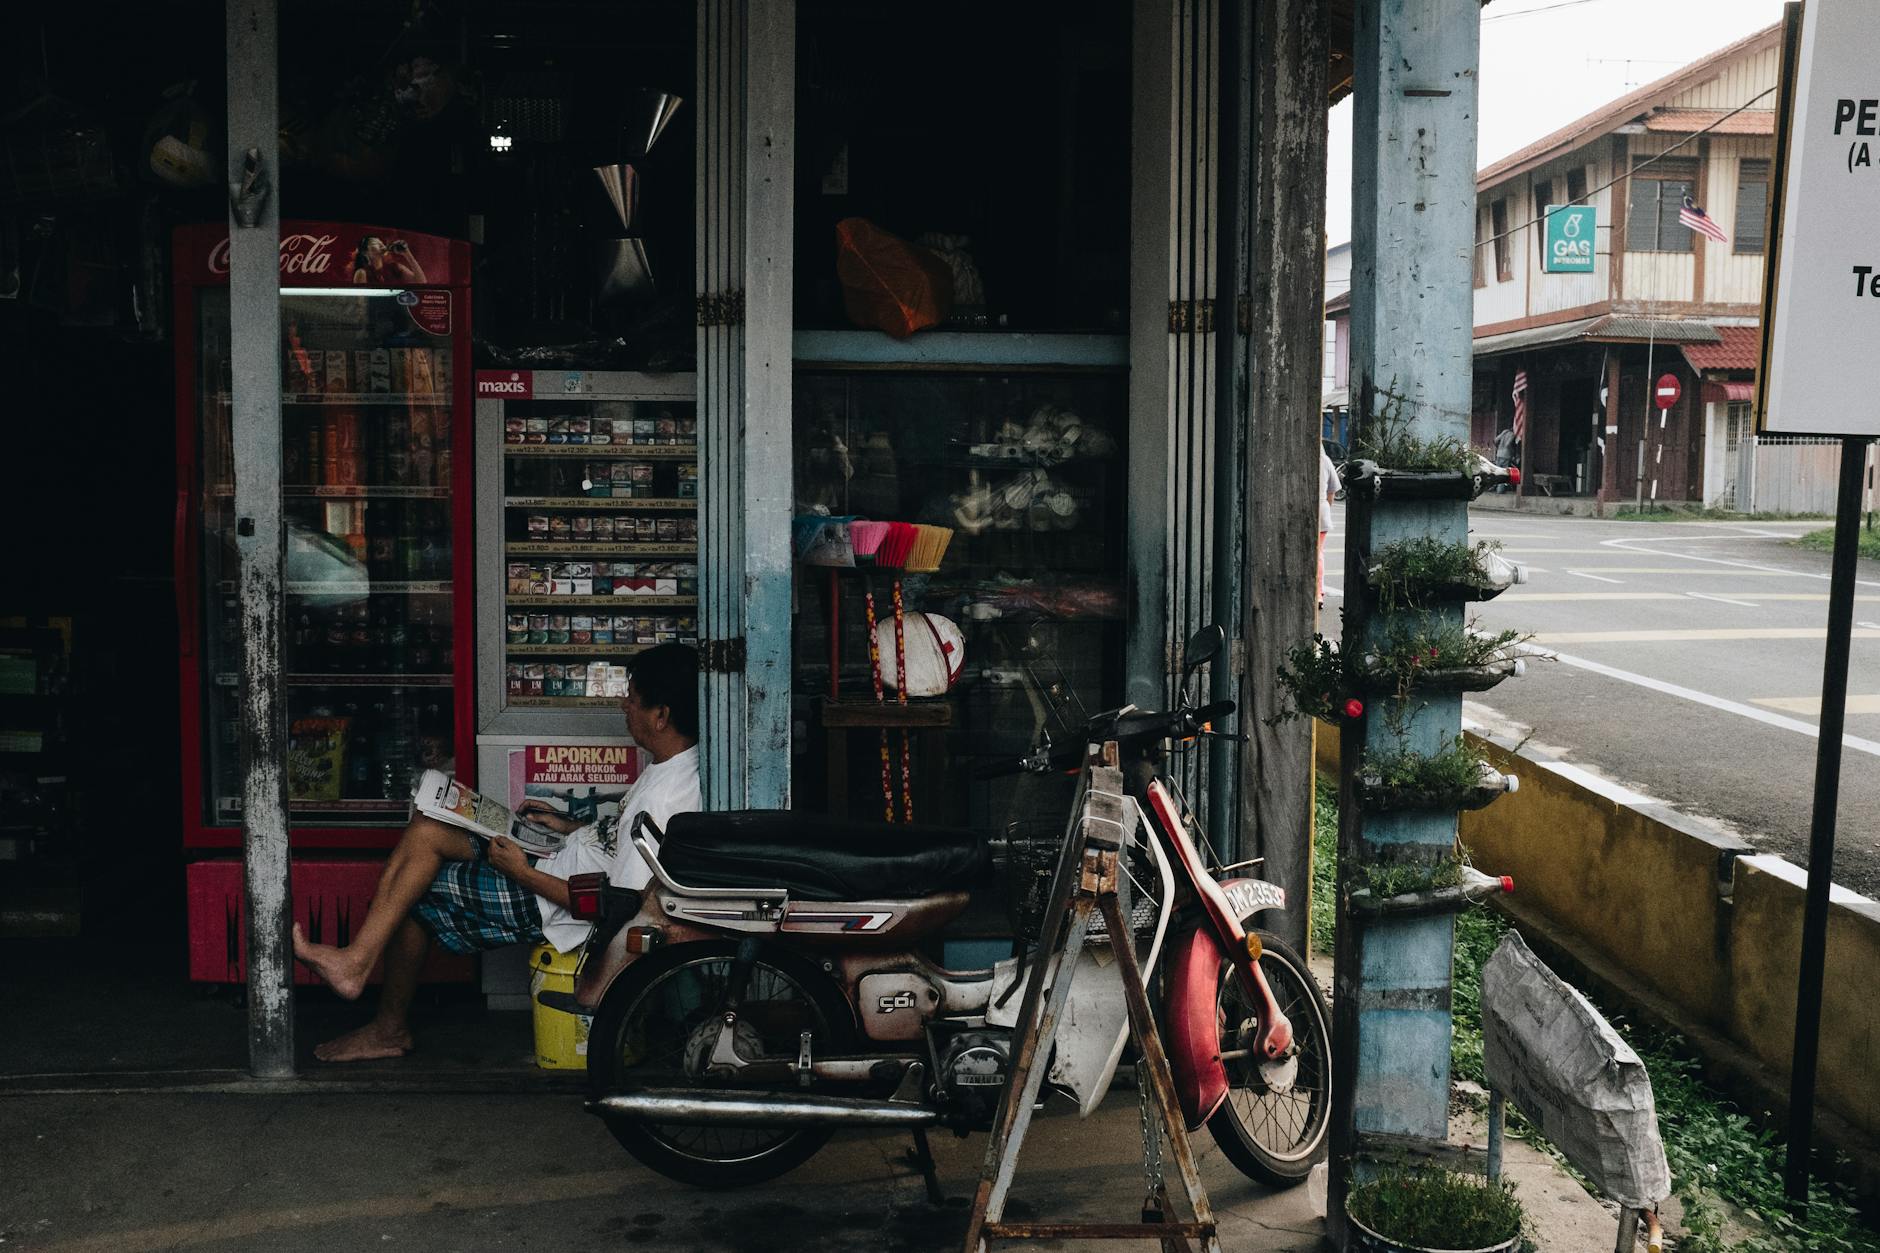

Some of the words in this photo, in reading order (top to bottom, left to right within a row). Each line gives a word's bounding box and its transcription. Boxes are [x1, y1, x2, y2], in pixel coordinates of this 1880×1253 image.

[1833, 99, 1880, 136] PE
[1848, 142, 1871, 174] (A
[1553, 240, 1590, 257] GAS
[534, 747, 627, 764] LAPORKAN
[546, 764, 583, 773] JUALAN
[585, 764, 616, 774] ROKOK
[533, 773, 558, 783] ATAU
[560, 773, 586, 783] ARAK
[588, 773, 629, 783] SELUDUP
